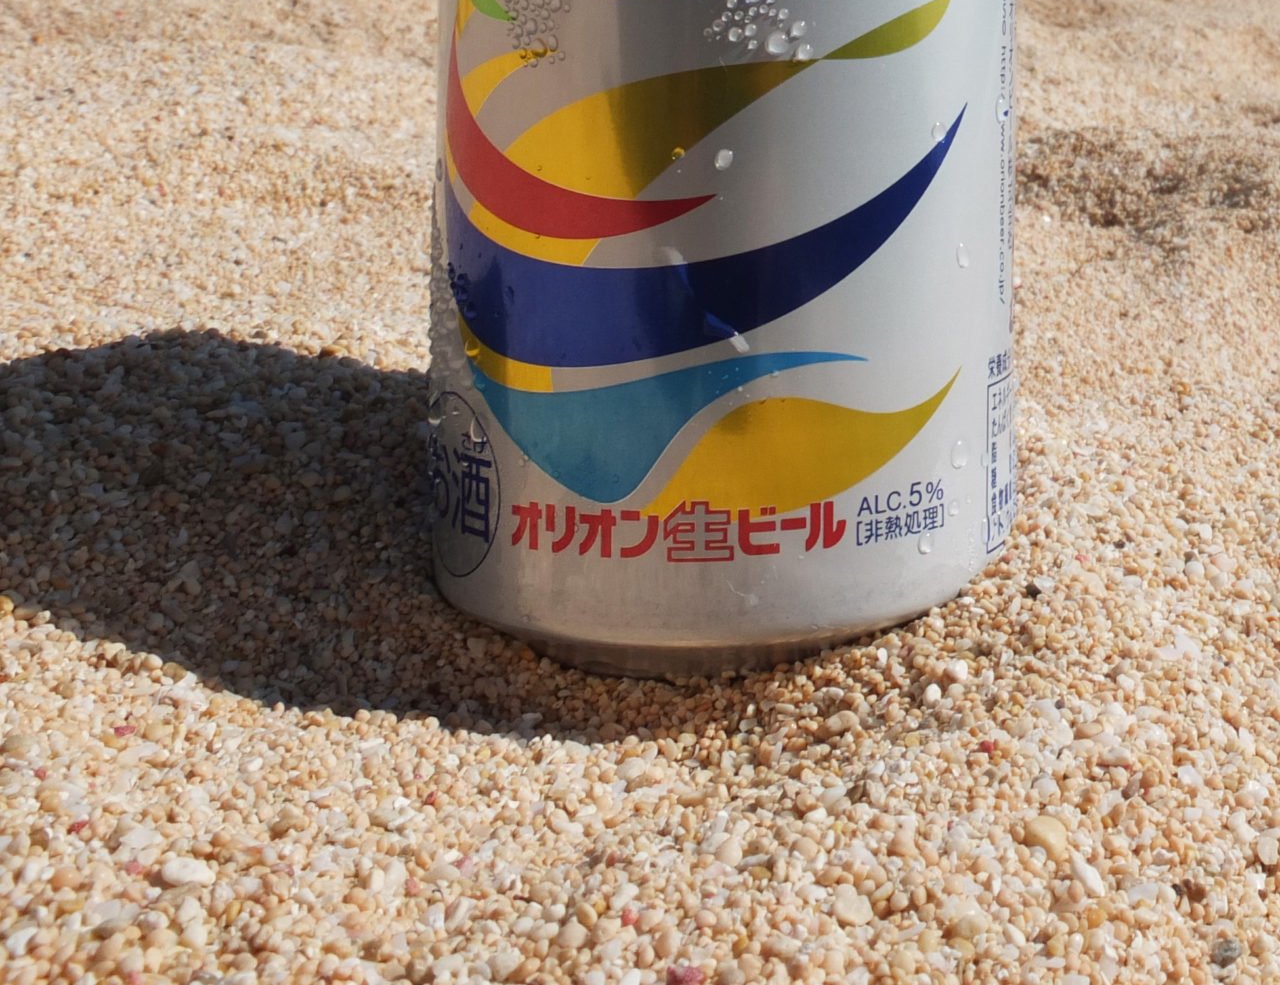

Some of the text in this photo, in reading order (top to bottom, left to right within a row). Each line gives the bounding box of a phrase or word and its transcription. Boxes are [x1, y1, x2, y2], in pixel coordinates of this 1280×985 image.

[511, 499, 847, 563] オリオン生ビール
